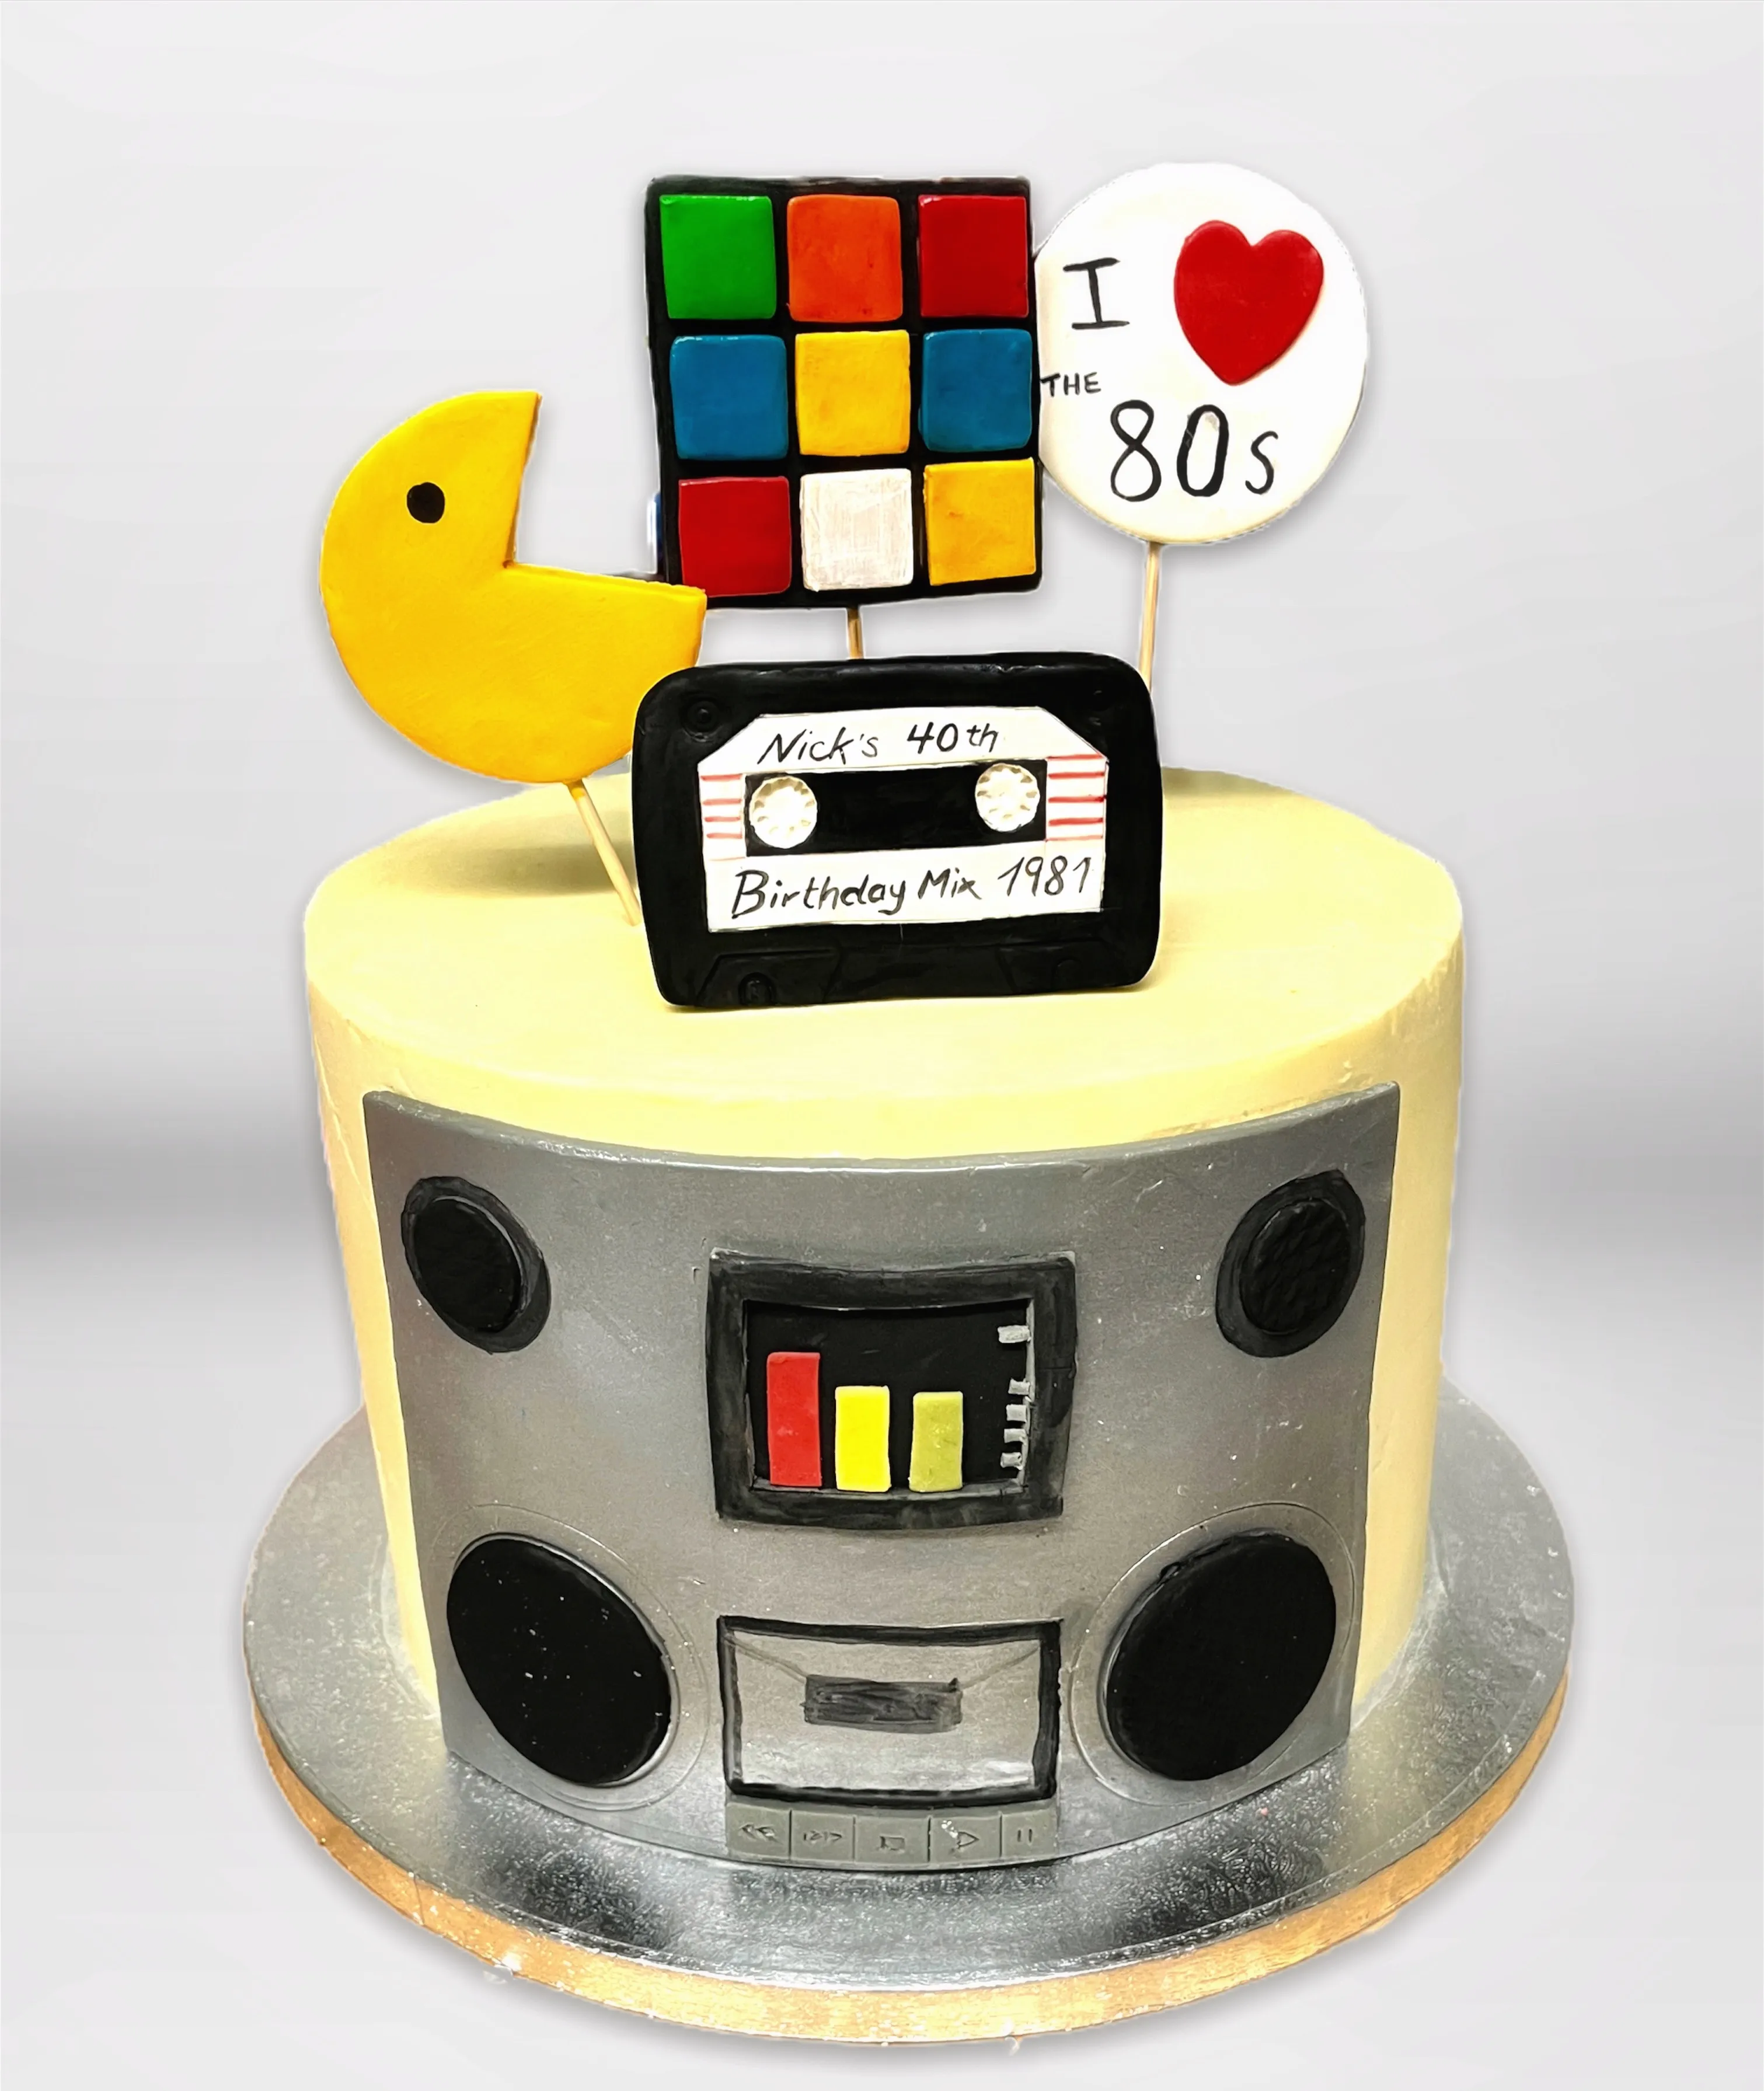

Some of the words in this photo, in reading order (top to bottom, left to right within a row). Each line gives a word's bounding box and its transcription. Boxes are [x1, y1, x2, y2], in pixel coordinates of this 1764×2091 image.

[1063, 257, 1129, 329] I
[1040, 372, 1101, 398] THE
[1110, 399, 1278, 502] 80s
[757, 726, 878, 765] Nick's
[906, 722, 998, 755] 40th
[731, 868, 907, 919] Birthday
[918, 866, 982, 901] Mix
[998, 856, 1093, 897] 1981
